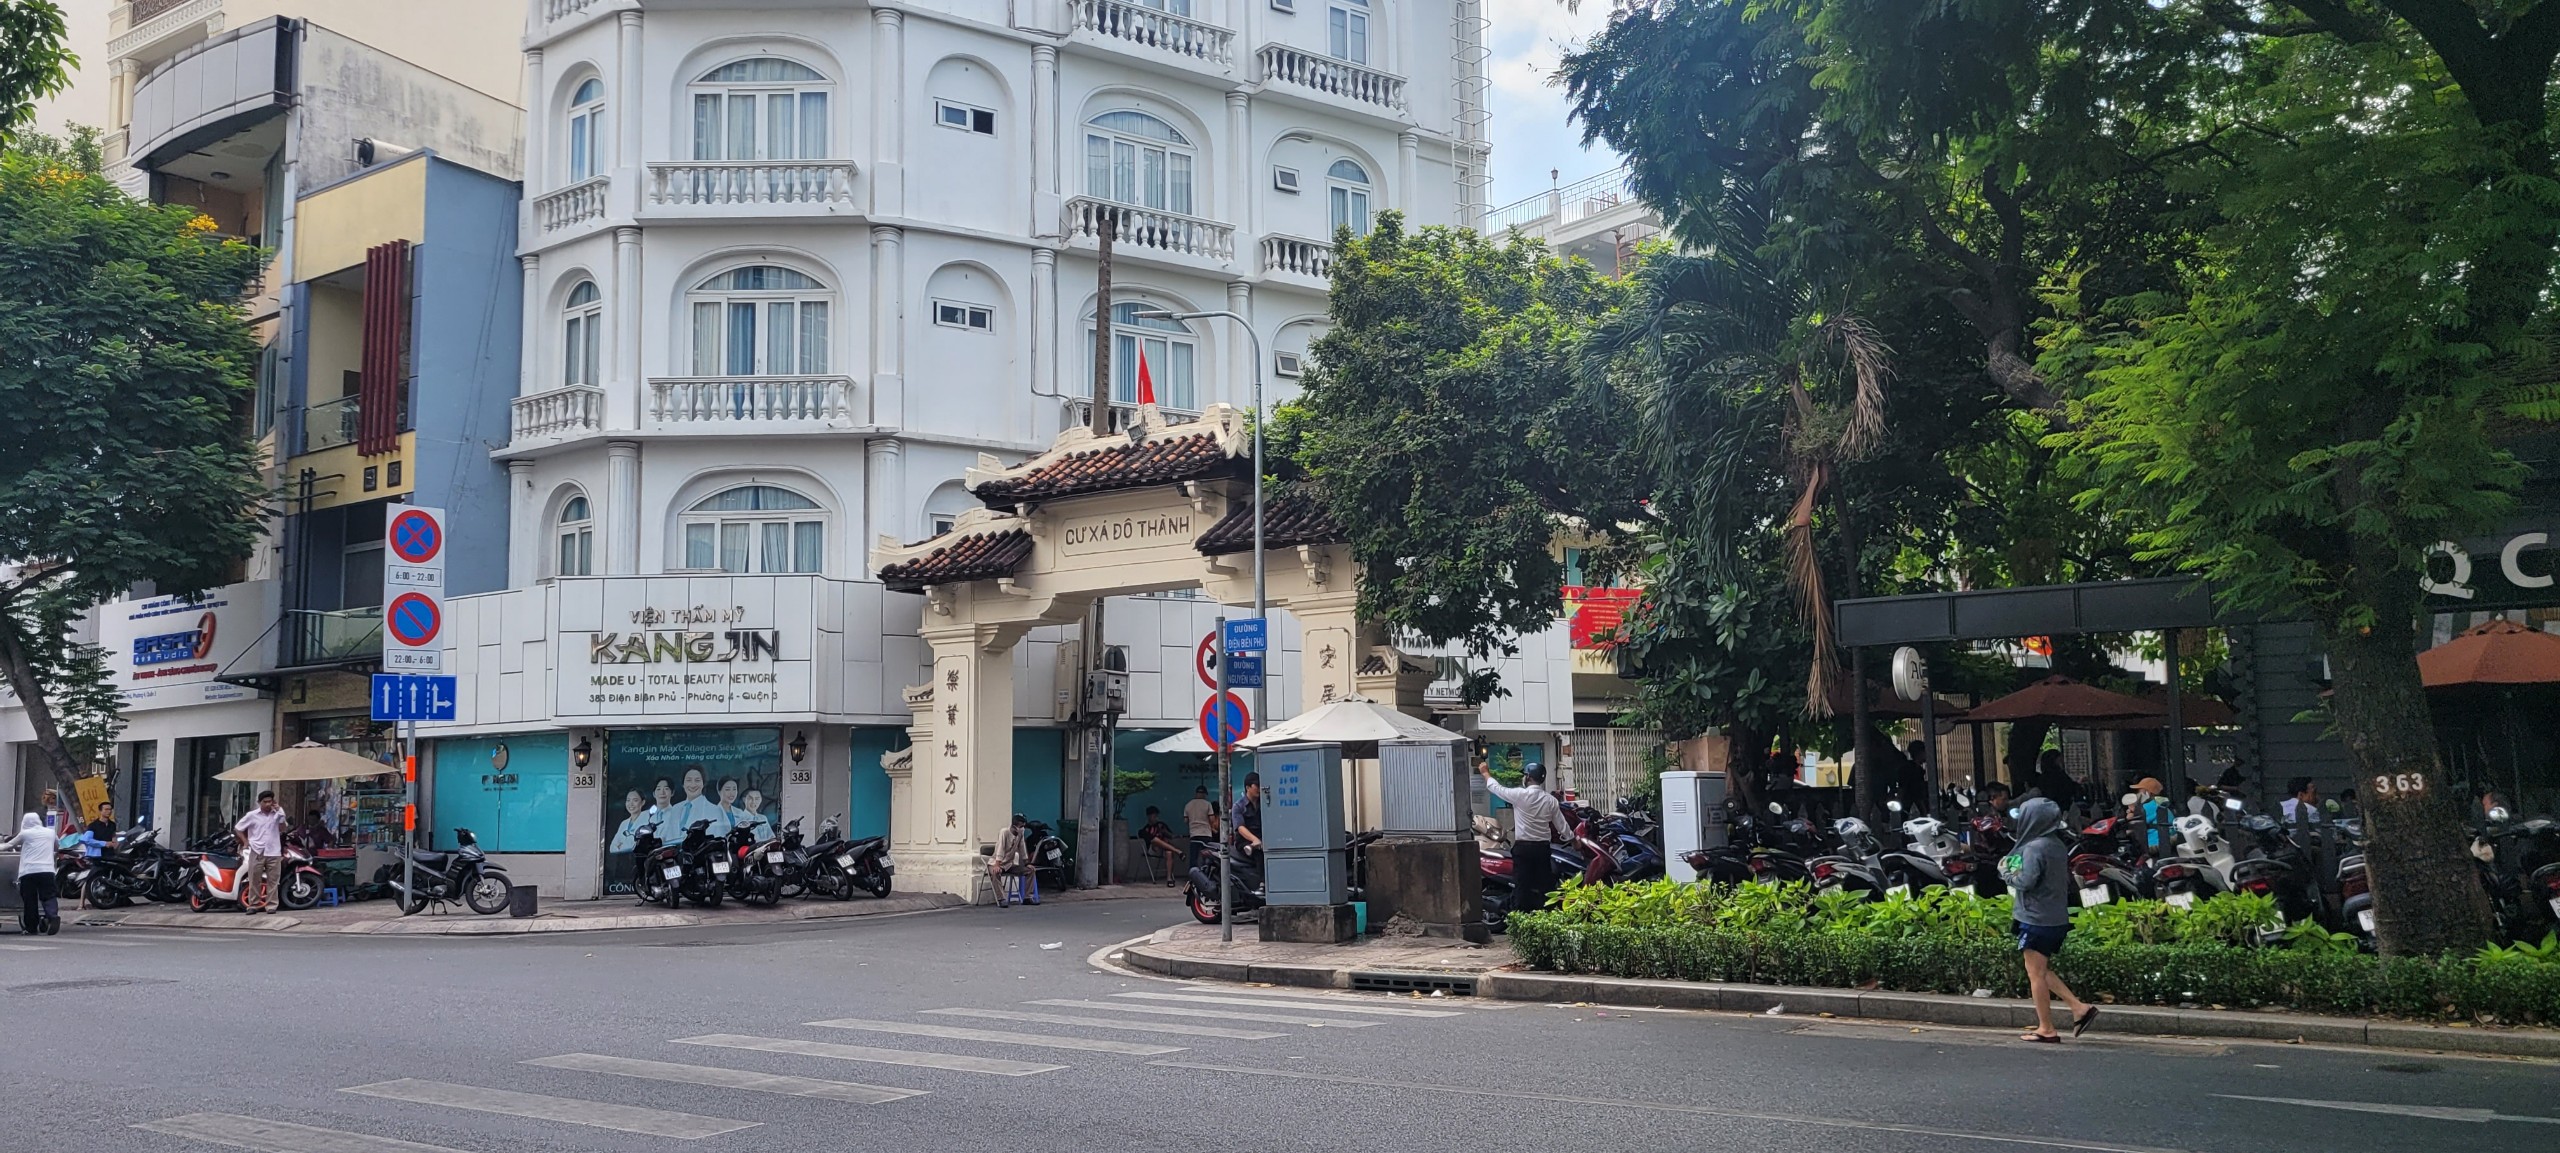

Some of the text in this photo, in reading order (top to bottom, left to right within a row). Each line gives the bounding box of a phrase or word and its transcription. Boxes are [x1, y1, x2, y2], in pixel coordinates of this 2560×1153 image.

[1089, 519, 1109, 542] XÁ
[1113, 517, 1133, 540] ĐÔ
[1137, 513, 1190, 538] THÀNH
[395, 571, 410, 580] 6:00
[417, 572, 435, 582] 22:00
[629, 606, 666, 627] VIỆN
[721, 605, 745, 623] MỸ
[155, 650, 189, 661] Audio
[394, 654, 412, 664] 22:00
[419, 655, 434, 664] 6:00
[590, 675, 625, 687] MADE
[627, 675, 636, 686] U
[647, 674, 680, 686] TOTAL
[683, 674, 724, 685] BEAUTY
[729, 673, 778, 684] NETWORK
[589, 693, 606, 703] 383
[687, 690, 725, 704] Phường
[575, 776, 593, 786] 383
[792, 771, 811, 782] 383
[609, 881, 635, 893] CÔN
